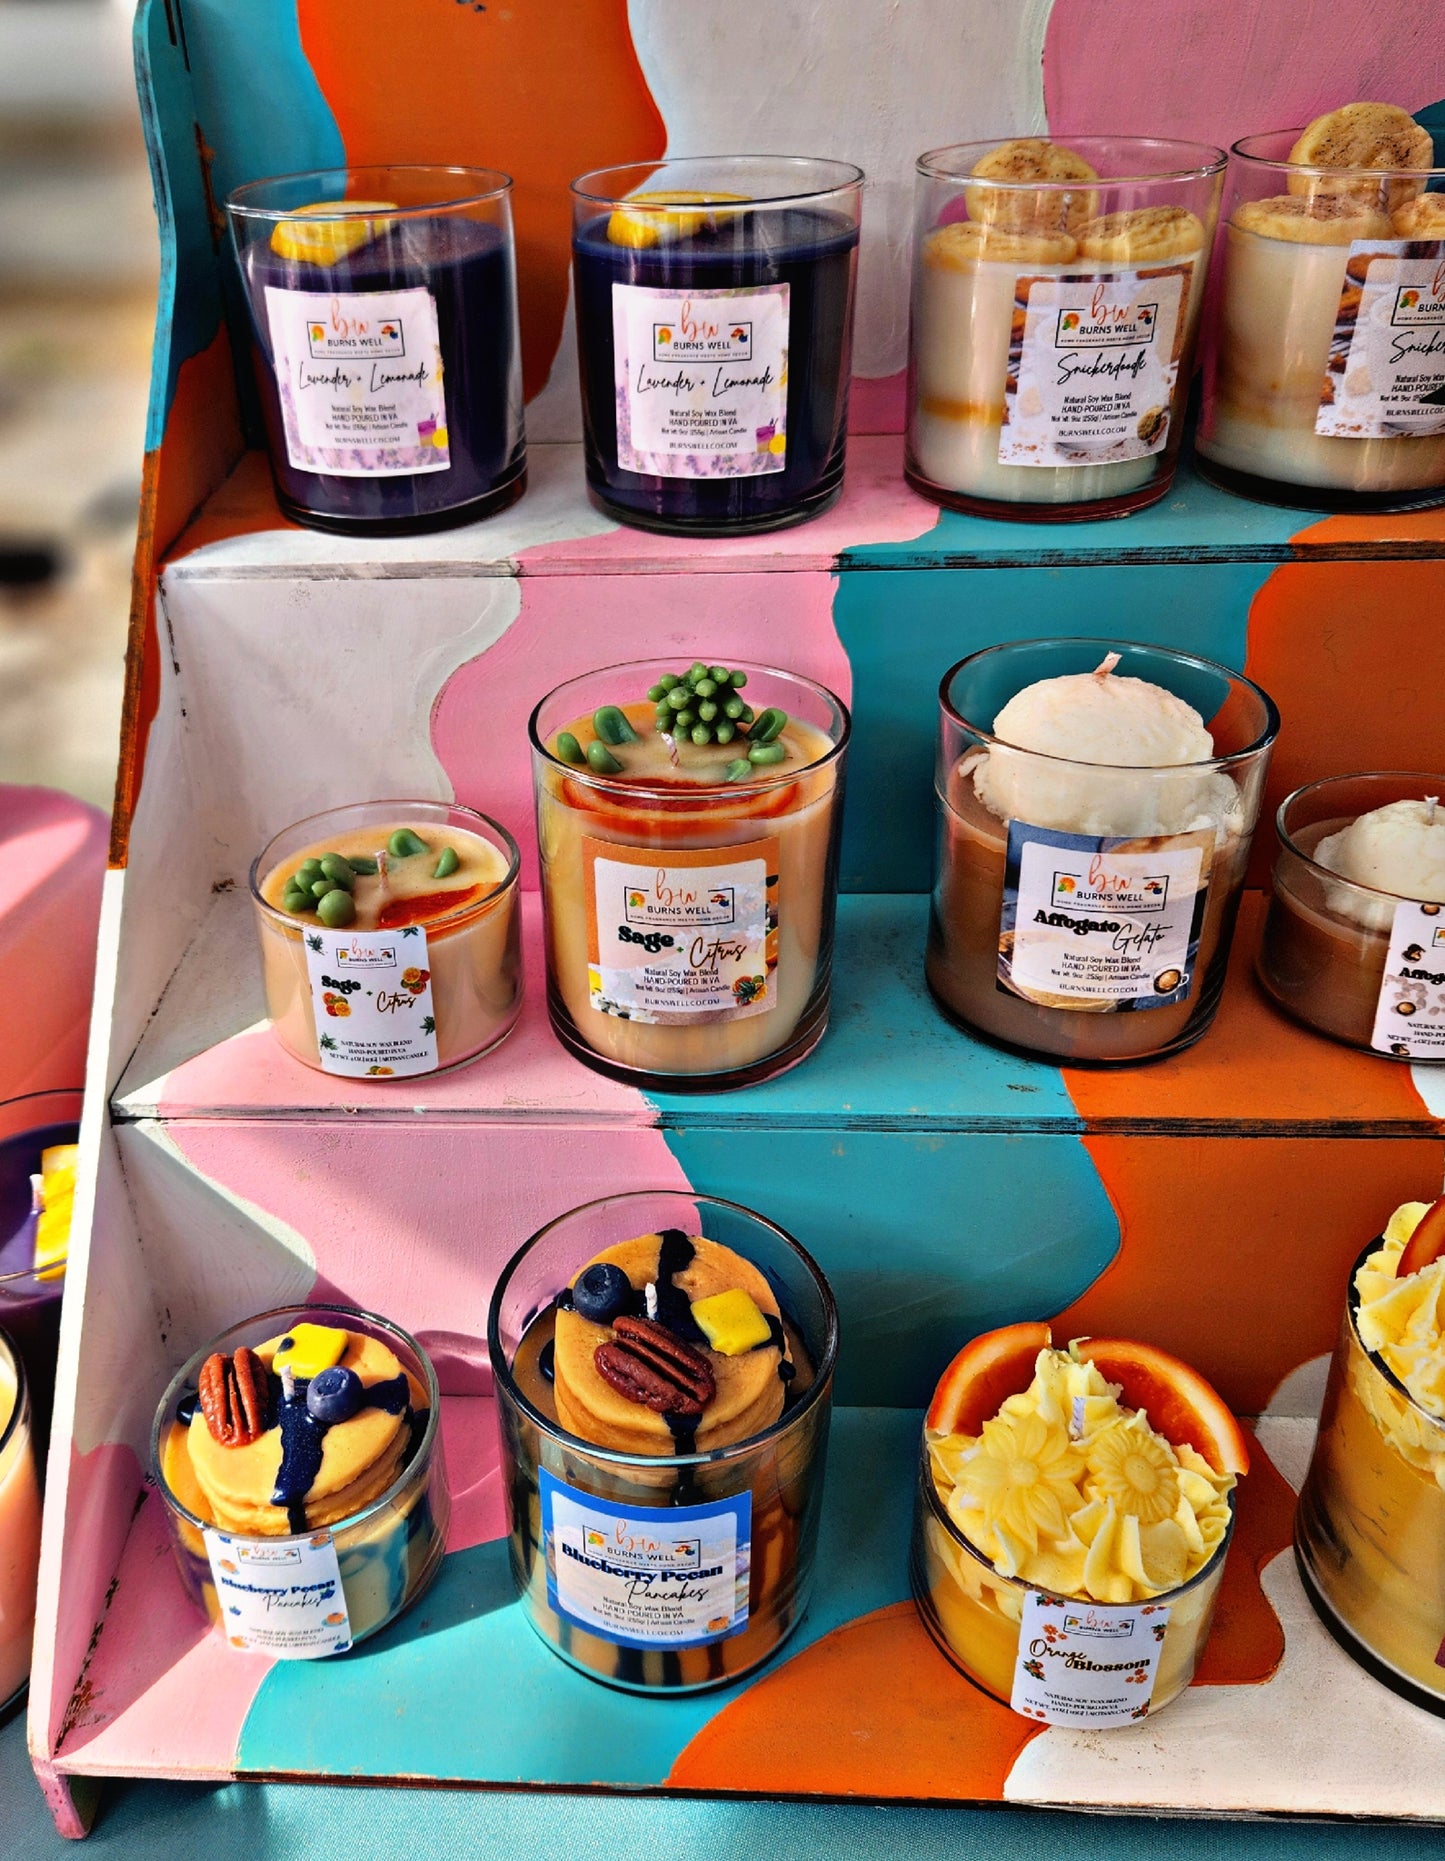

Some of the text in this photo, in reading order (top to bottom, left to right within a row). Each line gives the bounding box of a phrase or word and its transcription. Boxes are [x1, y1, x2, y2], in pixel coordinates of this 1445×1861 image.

[1091, 284, 1129, 325] bw
[681, 300, 719, 341] bw
[1079, 324, 1137, 334] BURNS WELL
[328, 338, 383, 347] BURNS WELL
[673, 341, 730, 350] BURNS WELL
[299, 361, 351, 391] Lavender
[370, 362, 429, 392] Lemonade
[1057, 349, 1147, 385] Snickerdoodle
[637, 364, 695, 396] Lavender
[712, 366, 775, 397] Lemonade
[1420, 374, 1431, 382] Soy
[1064, 396, 1086, 404] Natural
[1088, 395, 1099, 404] Soy
[1115, 392, 1132, 401] Blend
[691, 410, 702, 419] Soy
[1088, 855, 1133, 892] bw
[656, 869, 697, 906] bw
[1076, 891, 1143, 902] BURNS WELL
[647, 906, 712, 915] BURNS WELL
[1033, 909, 1121, 935] Affogato
[618, 925, 674, 953] Sage
[689, 937, 747, 969] Citrus
[1112, 923, 1174, 955] Gelato
[1064, 953, 1088, 962] Natural
[1090, 956, 1103, 965] Soy
[645, 968, 667, 976] Natural
[669, 969, 681, 977] Soy
[700, 968, 718, 976] Blend
[321, 975, 361, 995] Sage
[377, 991, 417, 1014] Citrus
[710, 984, 730, 992] Candle
[615, 1519, 661, 1553] bw
[562, 1542, 723, 1584] Blueberry Pecan
[607, 1547, 643, 1560] BURNS
[221, 1576, 336, 1597] Blueberry Pecan
[624, 1580, 709, 1604] Pancakes
[262, 1594, 322, 1612] Pancakes
[603, 1596, 627, 1607] Natural
[1029, 1638, 1087, 1667] Orange
[1073, 1659, 1150, 1672] Blossom
